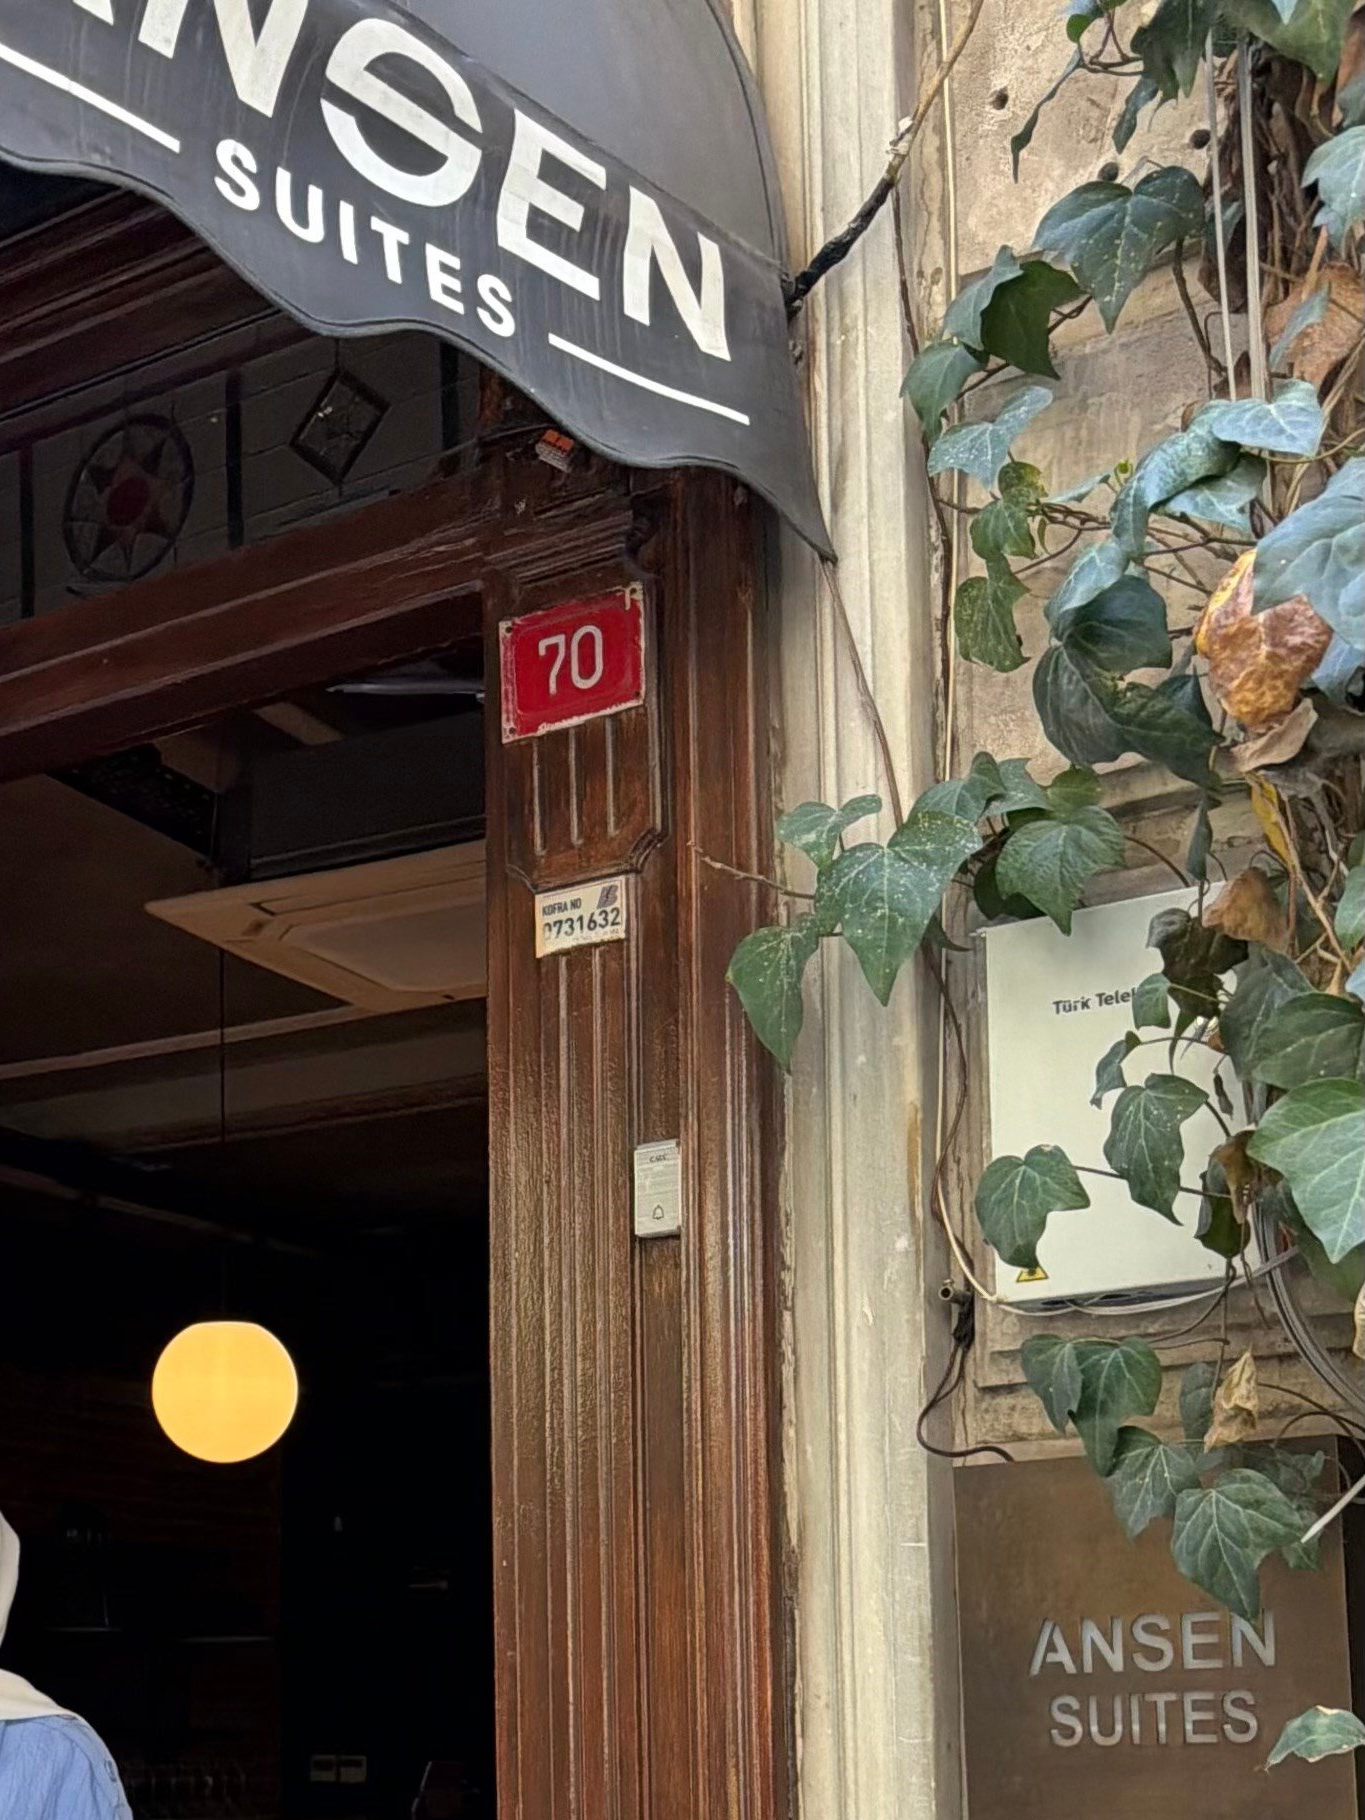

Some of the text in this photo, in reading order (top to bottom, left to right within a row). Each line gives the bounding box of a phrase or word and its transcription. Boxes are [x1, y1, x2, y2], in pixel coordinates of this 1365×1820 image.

[73, 0, 731, 361] NSEN
[215, 139, 516, 339] SUITES
[538, 625, 604, 695] 70
[1053, 987, 1137, 1015] Türk Tele
[1029, 1608, 1276, 1677] ANSEN
[1049, 1689, 1260, 1748] SUITES
